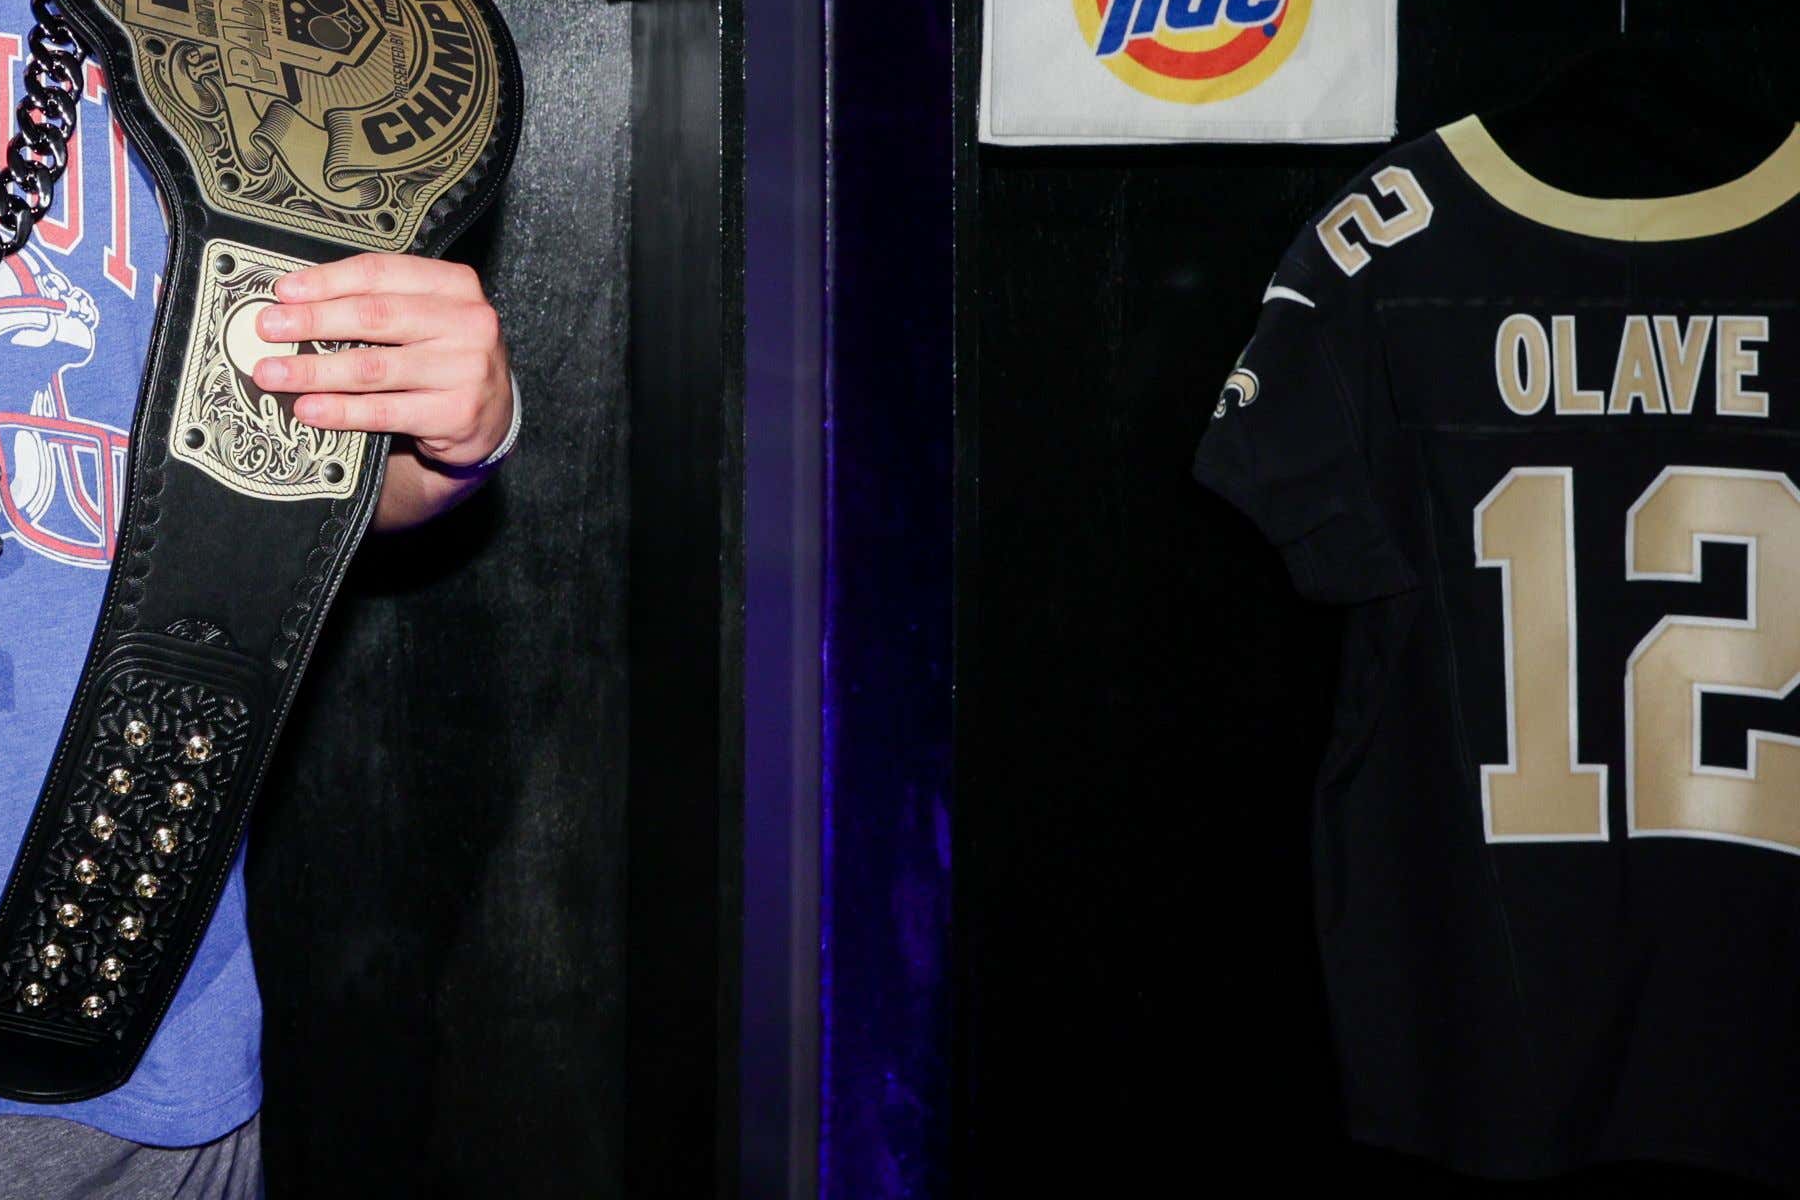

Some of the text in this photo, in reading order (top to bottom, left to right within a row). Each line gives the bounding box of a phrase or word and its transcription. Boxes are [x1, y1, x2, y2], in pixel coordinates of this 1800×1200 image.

[269, 2, 281, 26] SUPER
[391, 30, 409, 100] PRESENTED BY
[1494, 313, 1769, 417] OLAVE
[1473, 464, 1800, 856] 12
